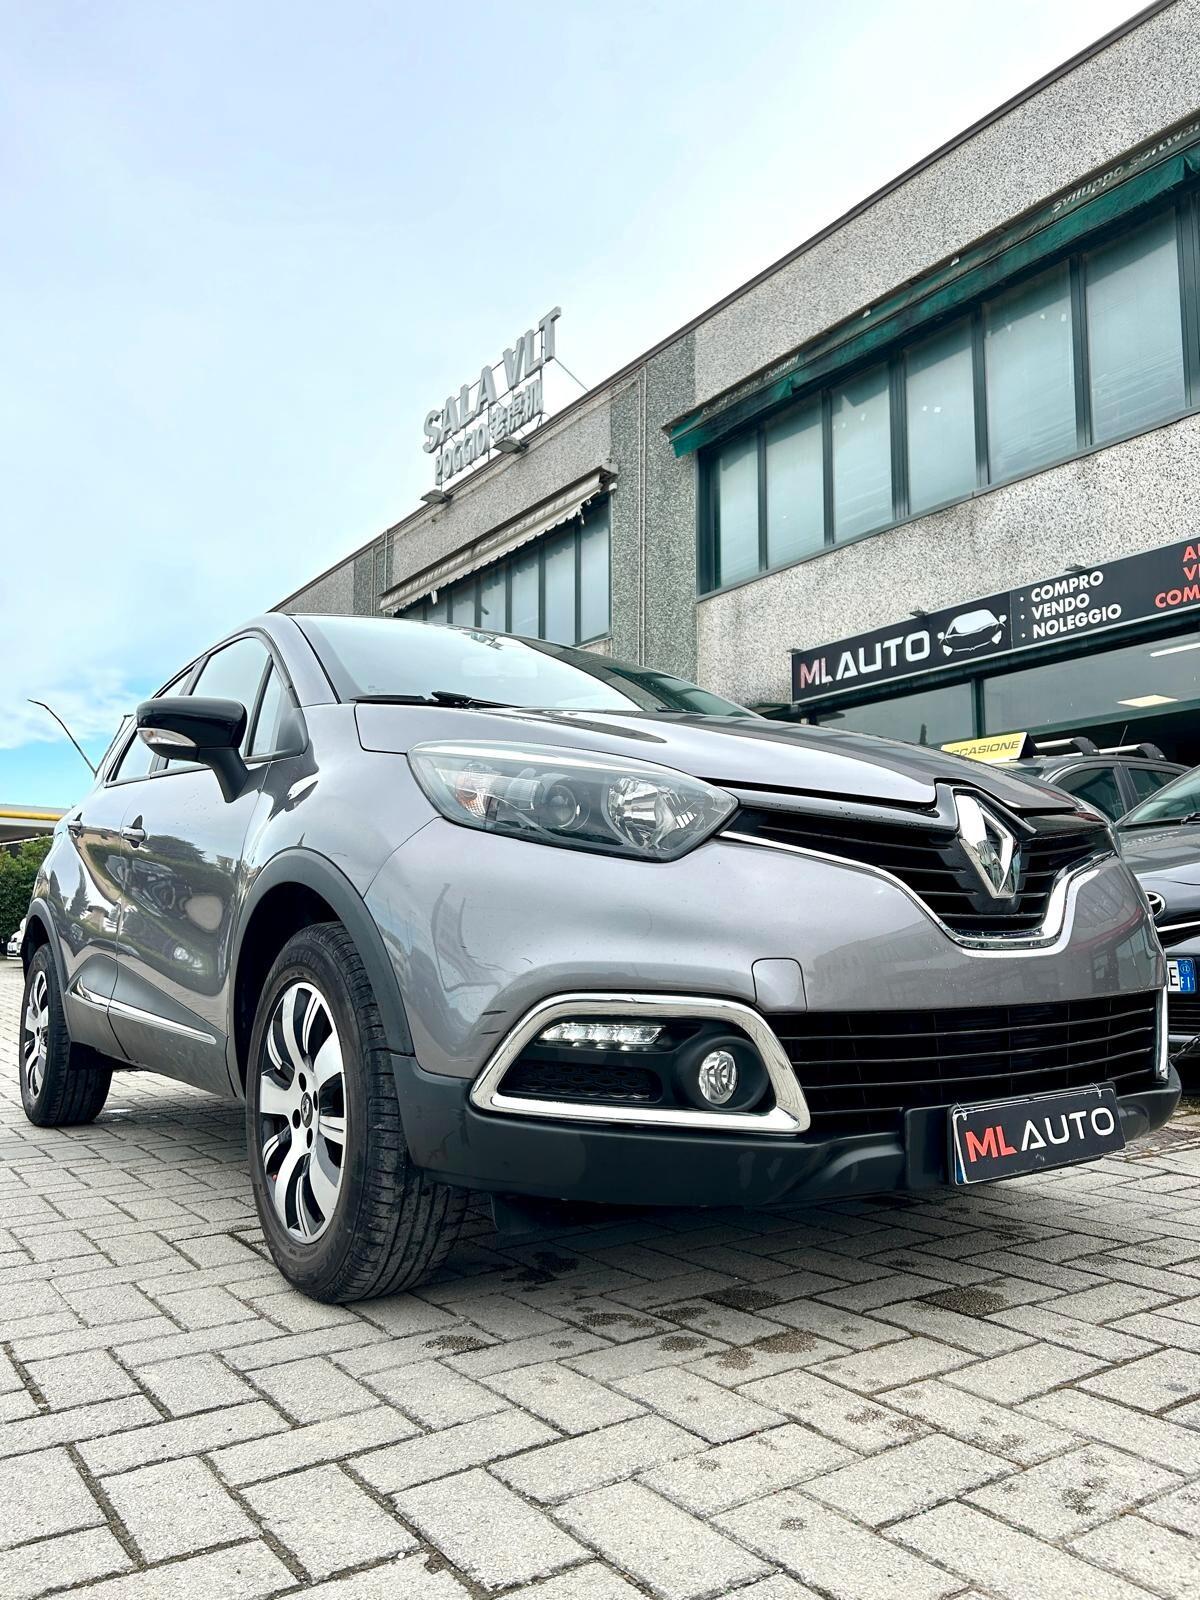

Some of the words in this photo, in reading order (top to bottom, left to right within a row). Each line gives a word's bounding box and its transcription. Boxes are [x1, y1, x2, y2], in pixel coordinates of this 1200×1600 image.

[423, 365, 497, 454] SALA
[502, 306, 562, 390] VLT
[435, 423, 490, 486] POGGIO
[1031, 570, 1104, 603] COMPRO
[1032, 593, 1090, 620] VENDO
[1033, 603, 1122, 640] NOLEGGIO
